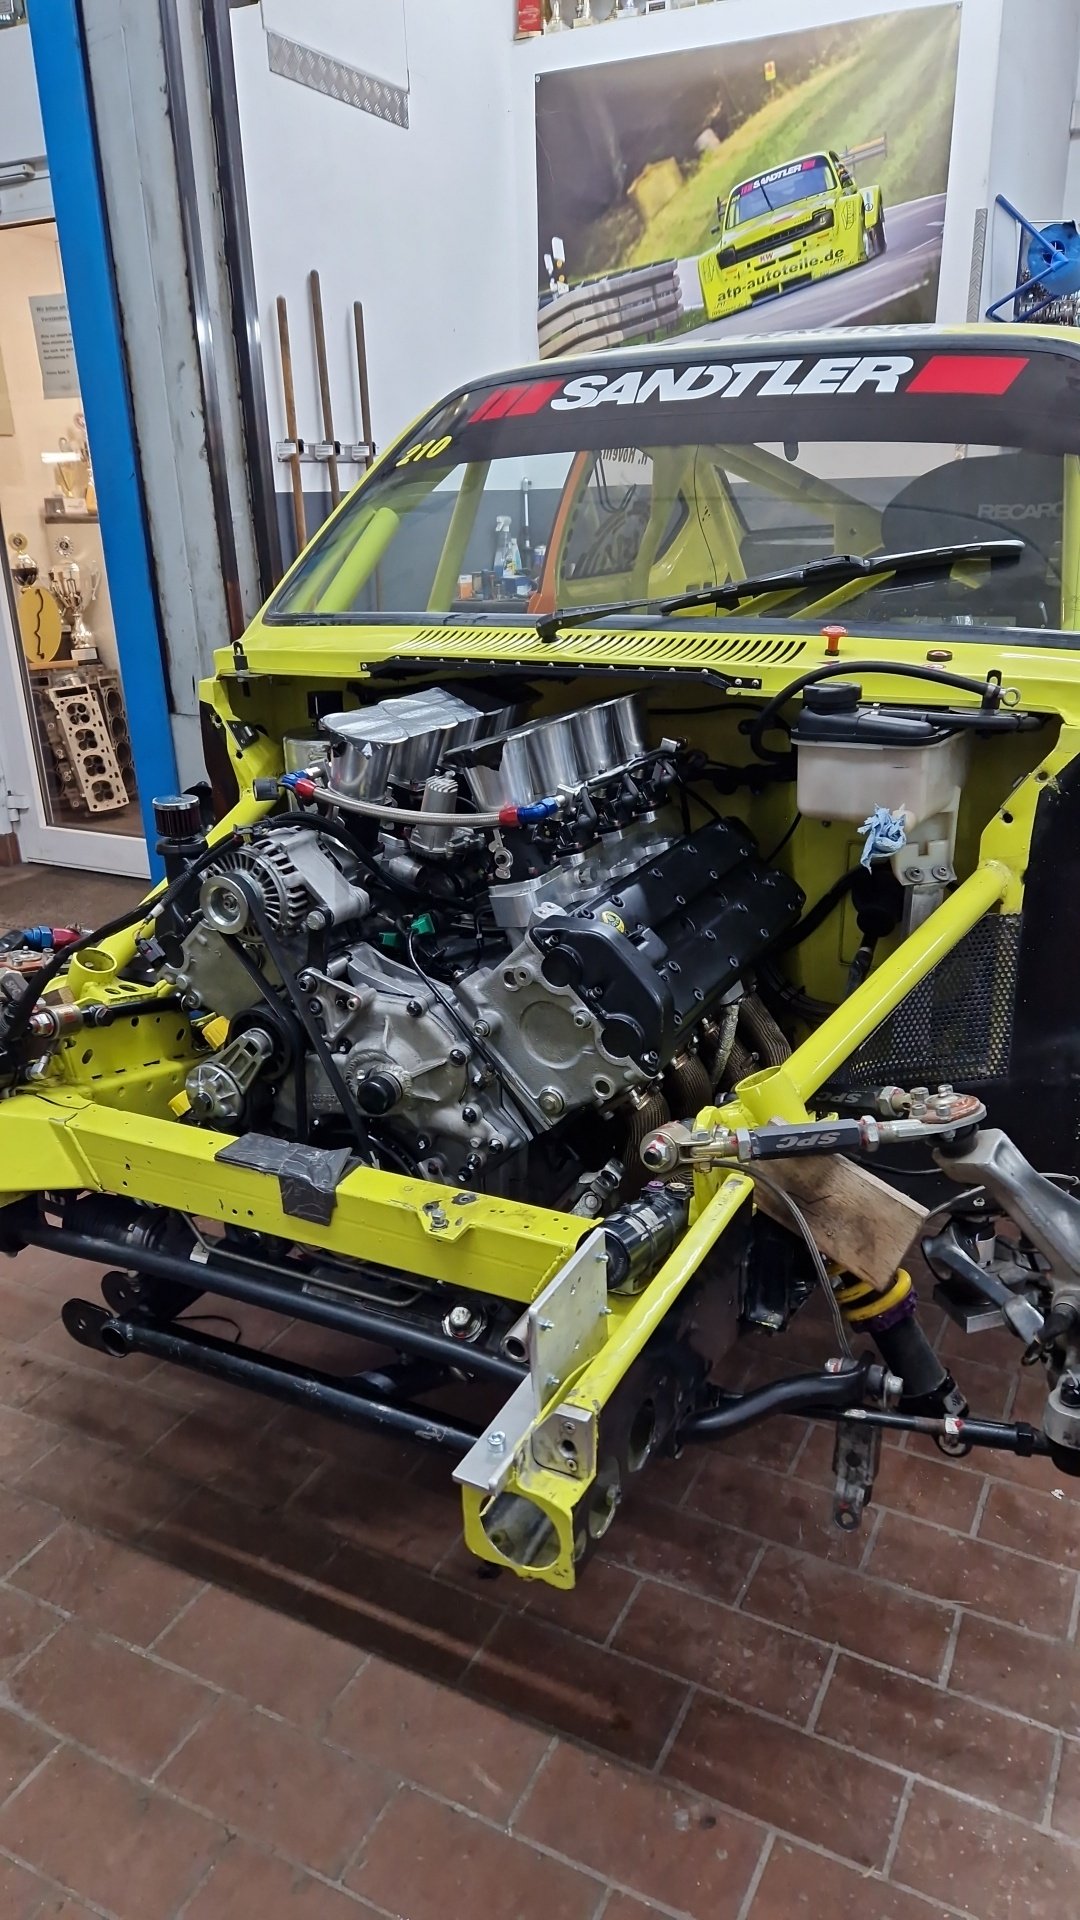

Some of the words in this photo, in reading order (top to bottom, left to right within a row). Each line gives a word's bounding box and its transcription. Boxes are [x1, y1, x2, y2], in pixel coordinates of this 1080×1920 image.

[753, 164, 802, 189] SANDTLER
[716, 248, 845, 303] atp-autoteile.de
[551, 355, 914, 411] SANDTLER
[395, 435, 453, 467] 210
[816, 1091, 862, 1104] SPC
[775, 1131, 841, 1149] SPC
